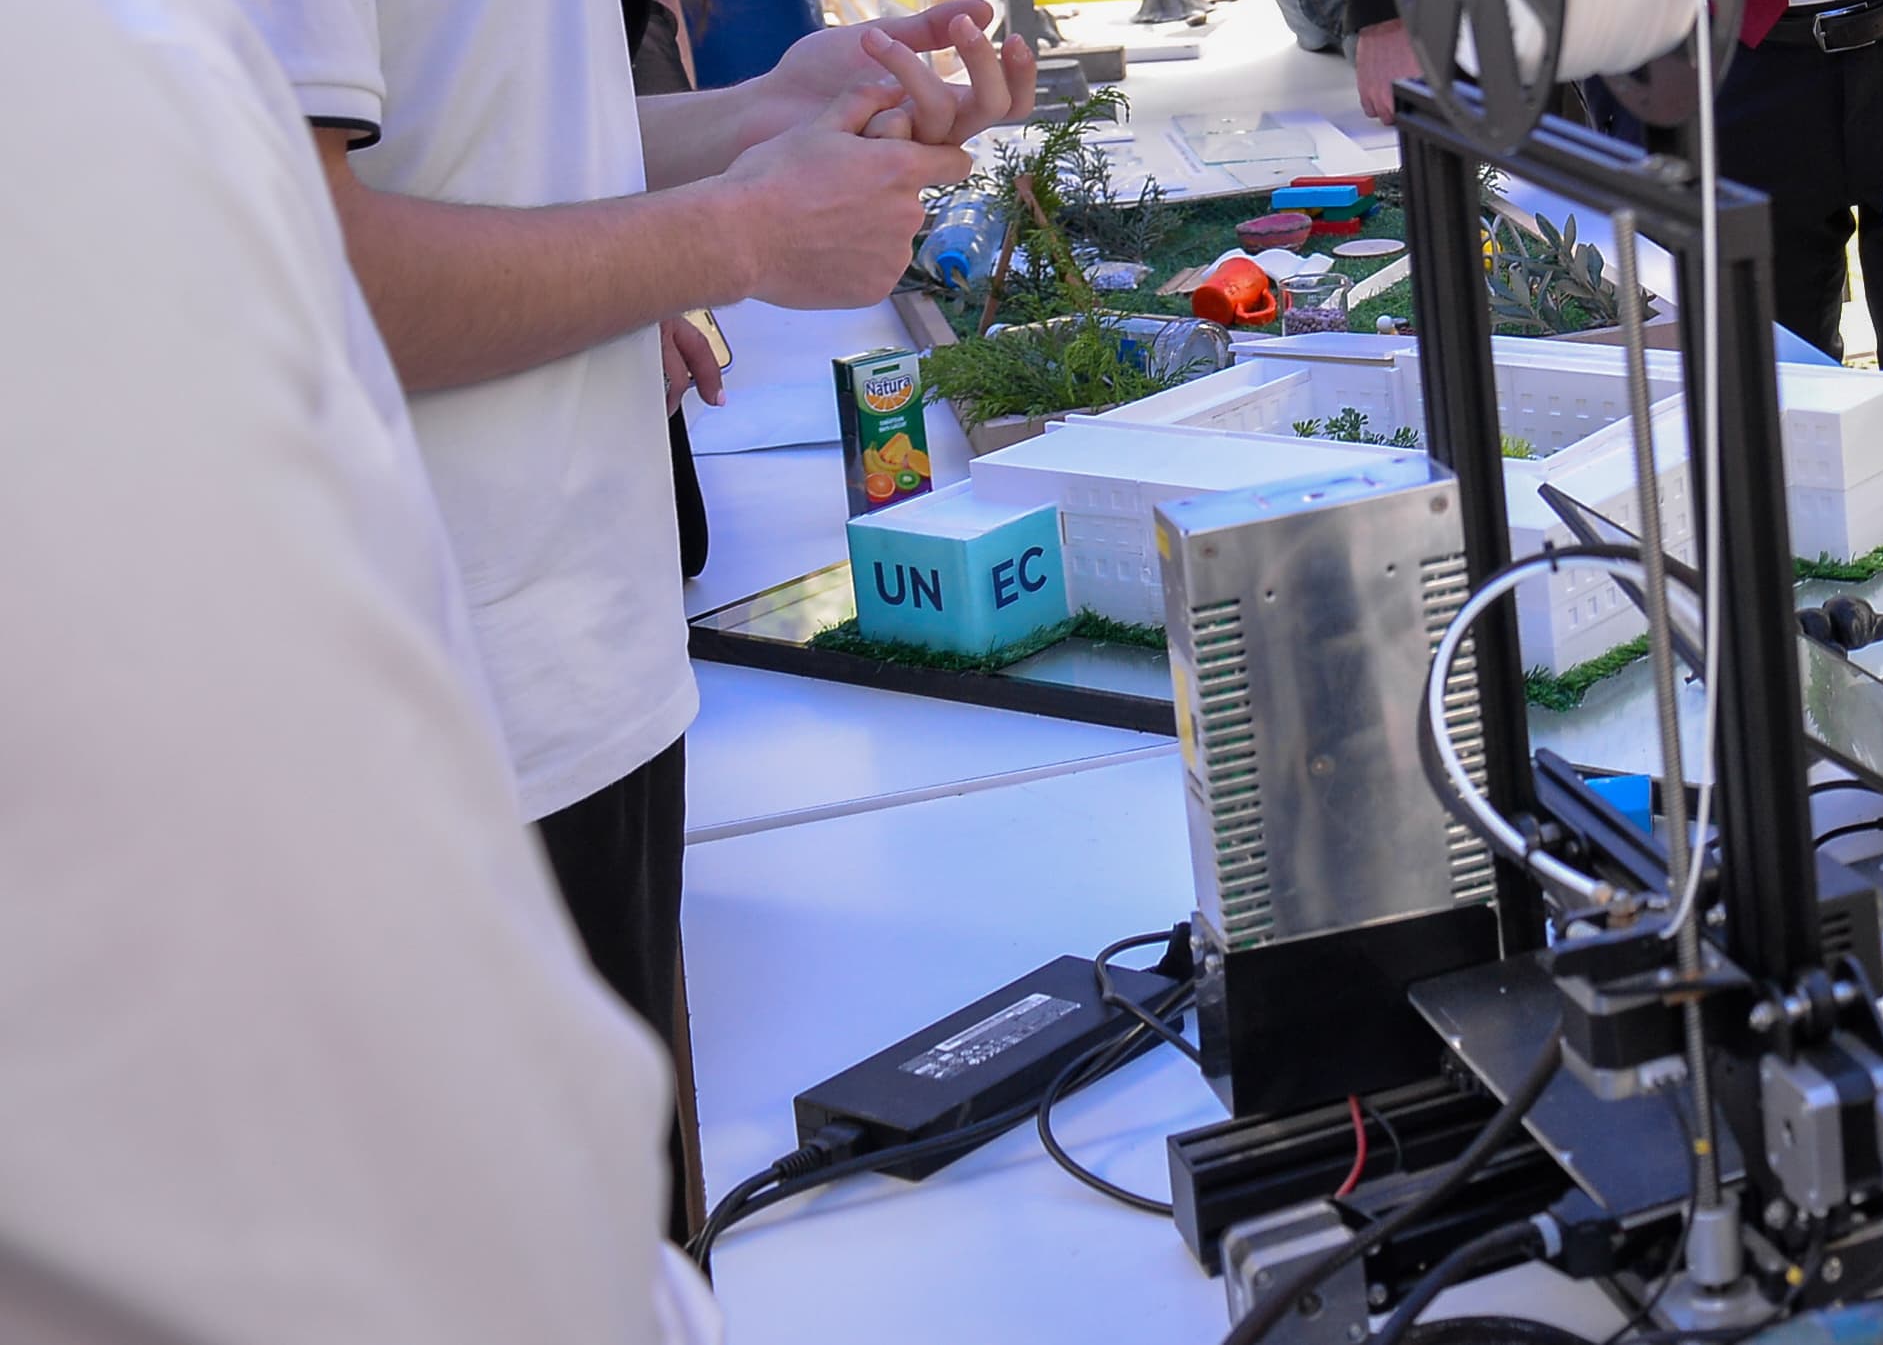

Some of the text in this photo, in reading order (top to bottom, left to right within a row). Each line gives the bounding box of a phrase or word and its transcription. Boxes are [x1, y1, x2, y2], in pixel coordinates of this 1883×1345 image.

[865, 376, 911, 396] Natura
[873, 561, 943, 612] UN
[991, 546, 1047, 609] EC
